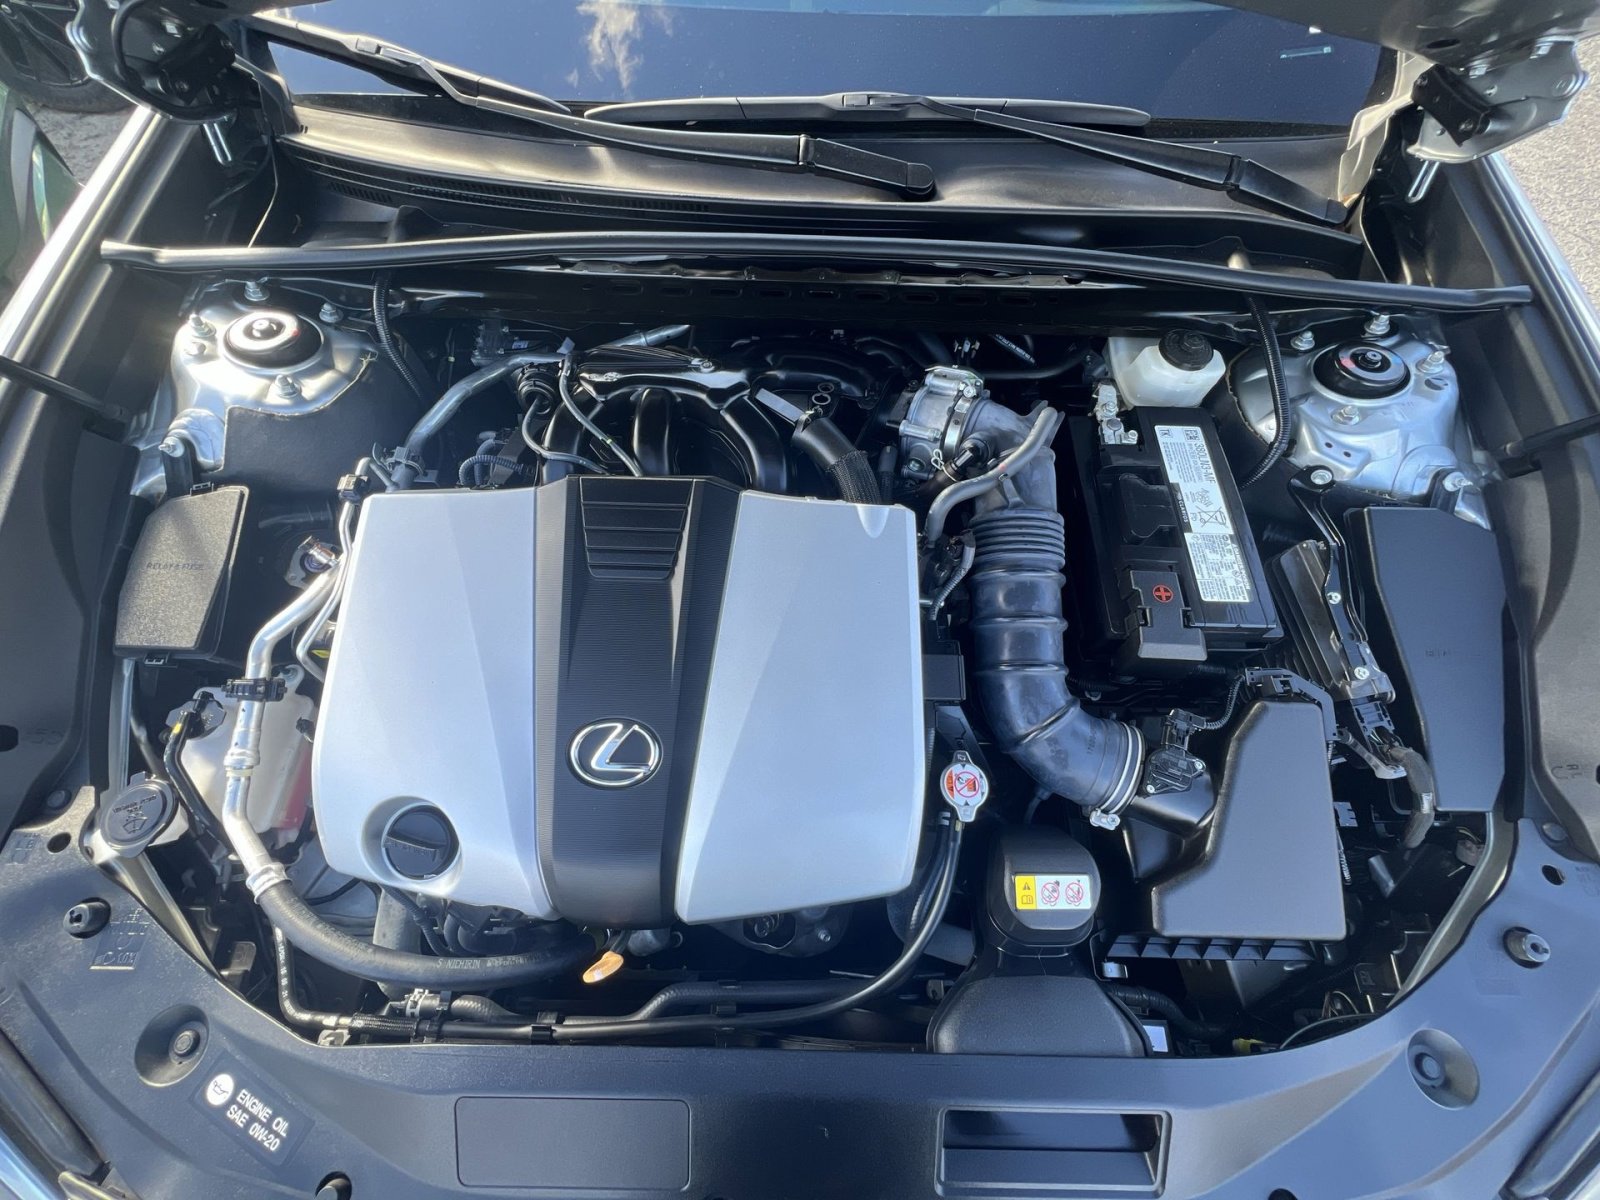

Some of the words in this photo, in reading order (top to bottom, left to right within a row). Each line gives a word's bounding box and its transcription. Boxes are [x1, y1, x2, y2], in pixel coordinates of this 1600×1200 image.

[226, 1104, 250, 1128] SAE
[248, 1122, 280, 1151] 0W-20
[236, 1088, 273, 1122] ENGINE
[271, 1116, 289, 1138] OIL
